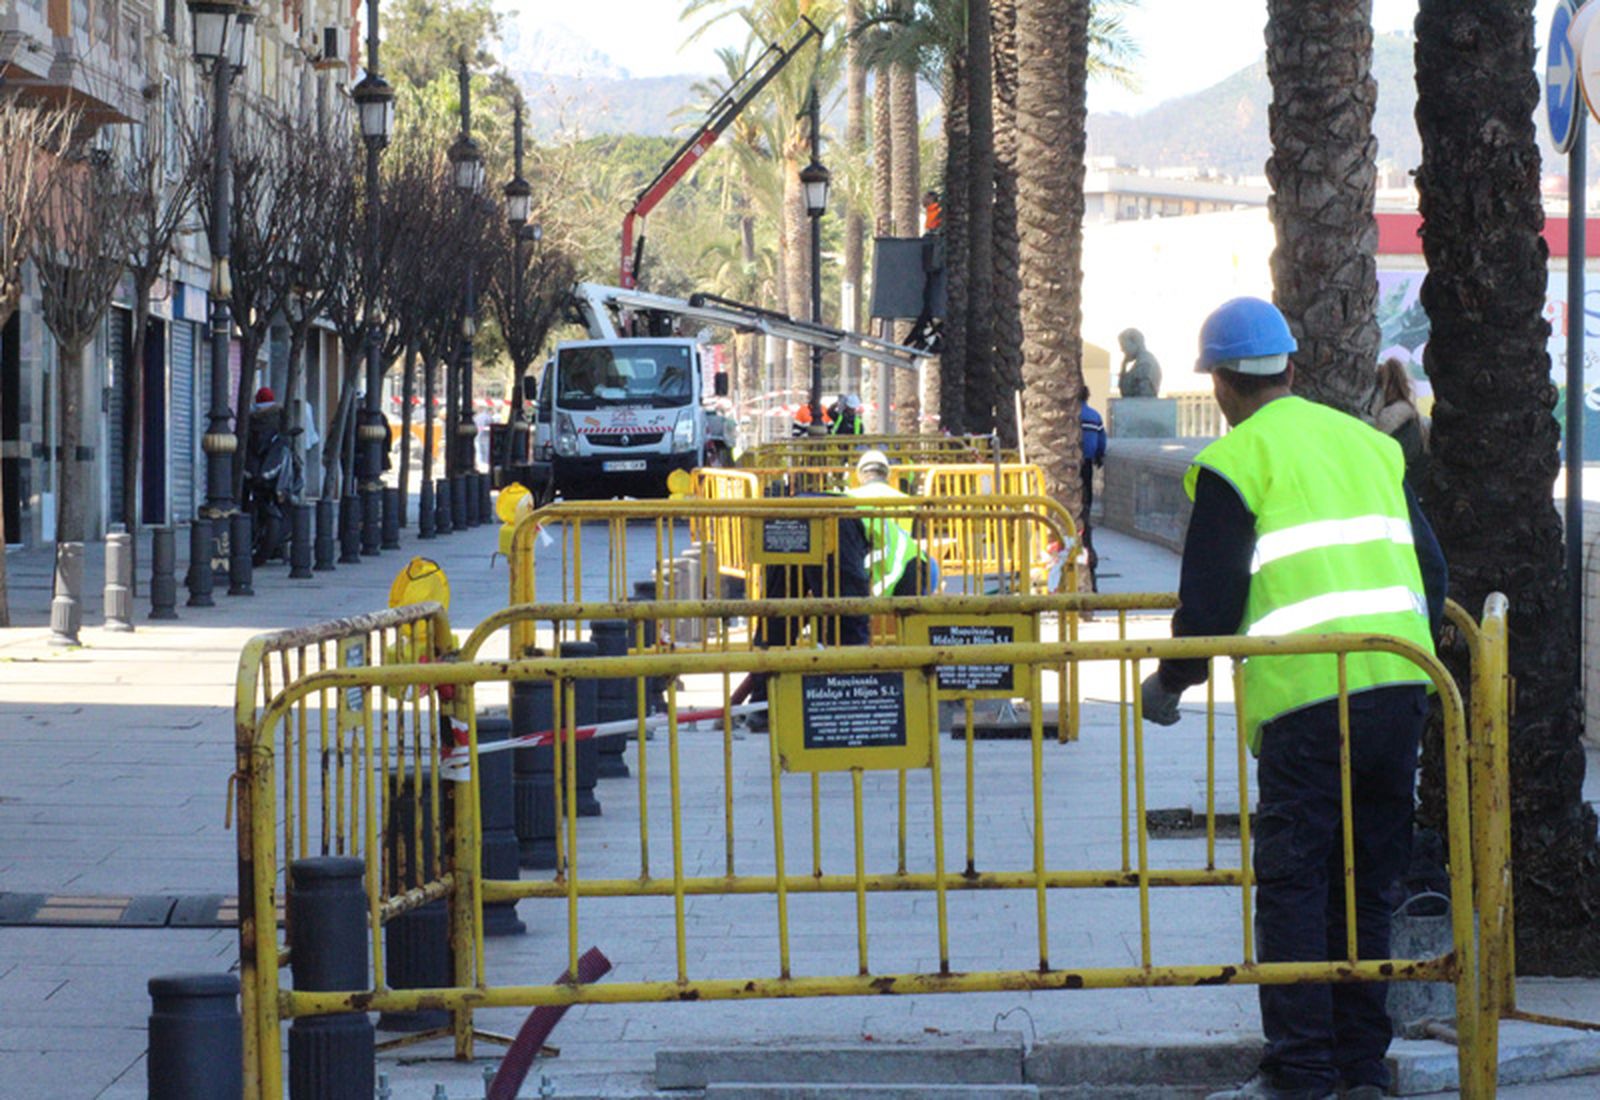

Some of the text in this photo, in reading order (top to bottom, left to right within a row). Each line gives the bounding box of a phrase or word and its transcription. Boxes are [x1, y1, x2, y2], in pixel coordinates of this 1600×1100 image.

[827, 676, 878, 686] Maquinaria
[806, 688, 843, 699] Hidalgo
[853, 687, 878, 698] Hijos
